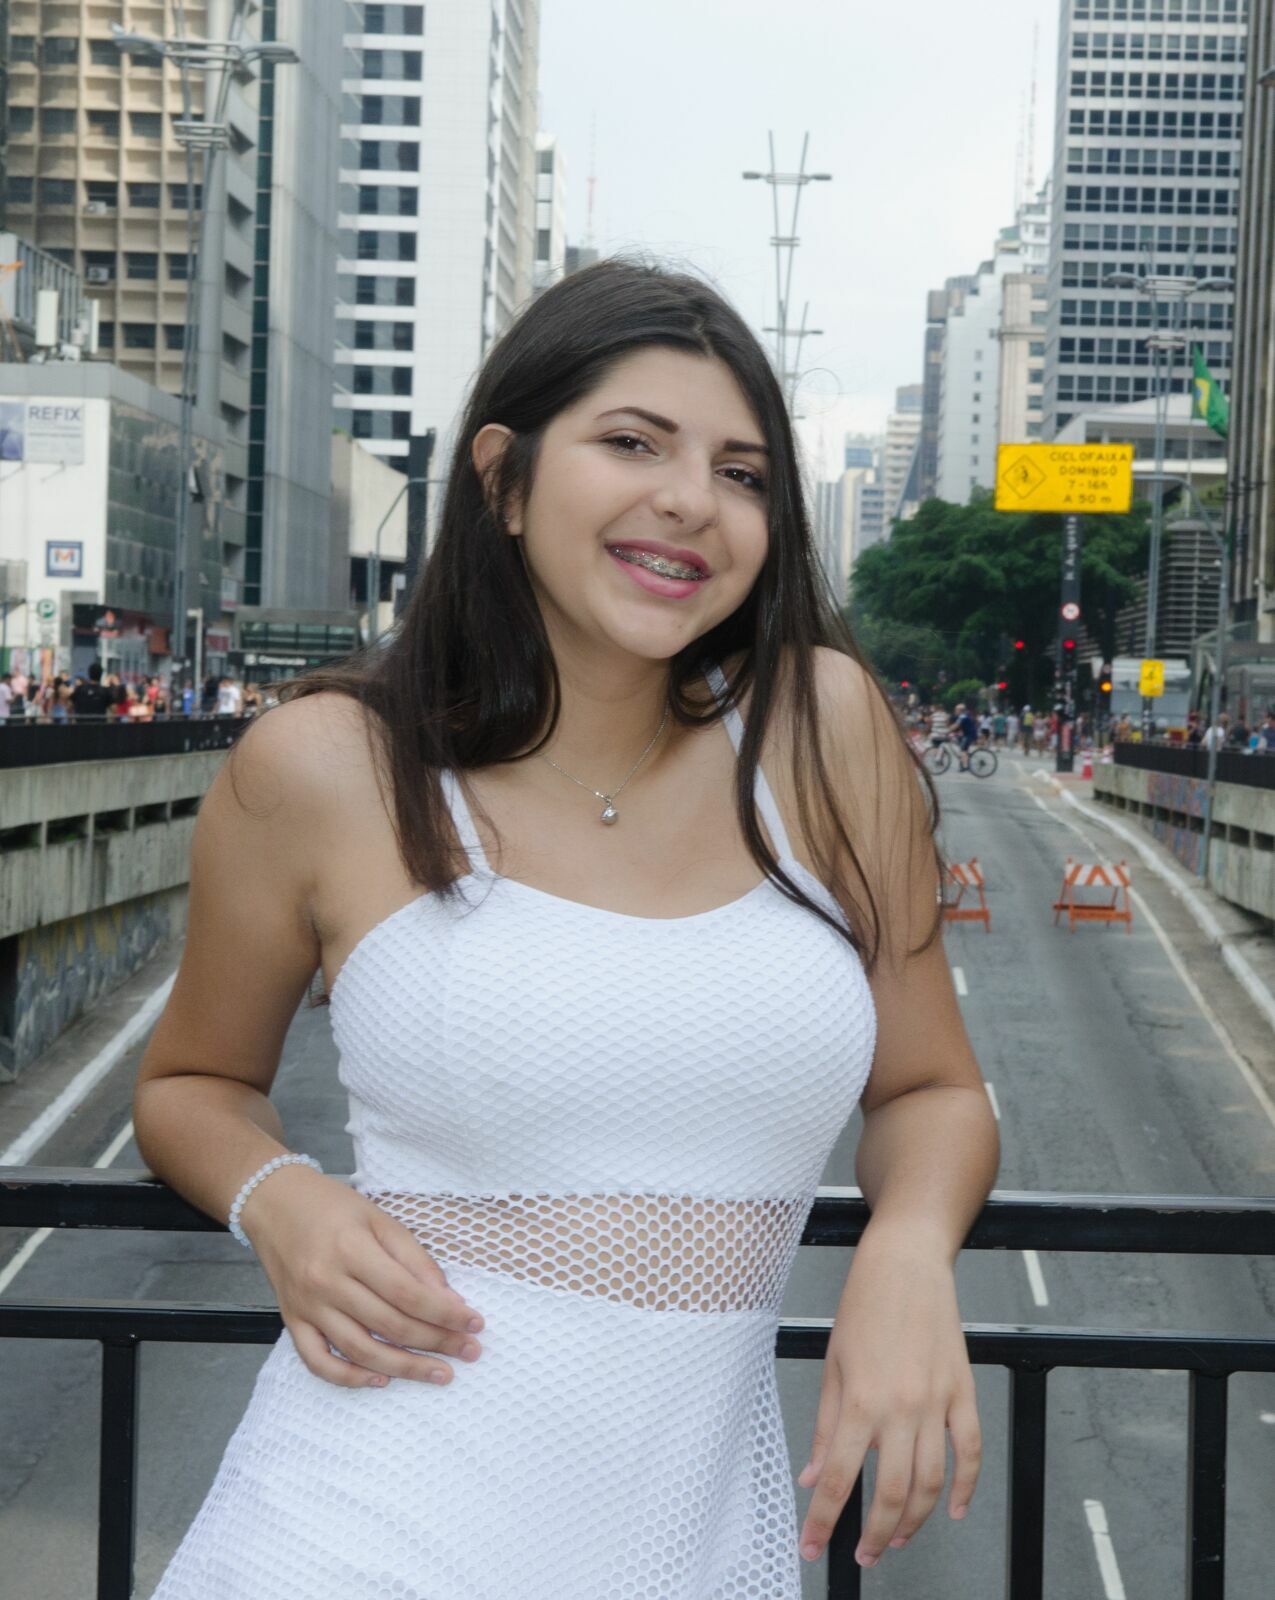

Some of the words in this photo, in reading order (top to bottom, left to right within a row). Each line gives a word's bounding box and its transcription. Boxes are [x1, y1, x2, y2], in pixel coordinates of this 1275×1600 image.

[29, 405, 81, 421] REFIX
[1050, 451, 1128, 462] CICLOFAIXA
[1059, 465, 1117, 476] DOMINGO
